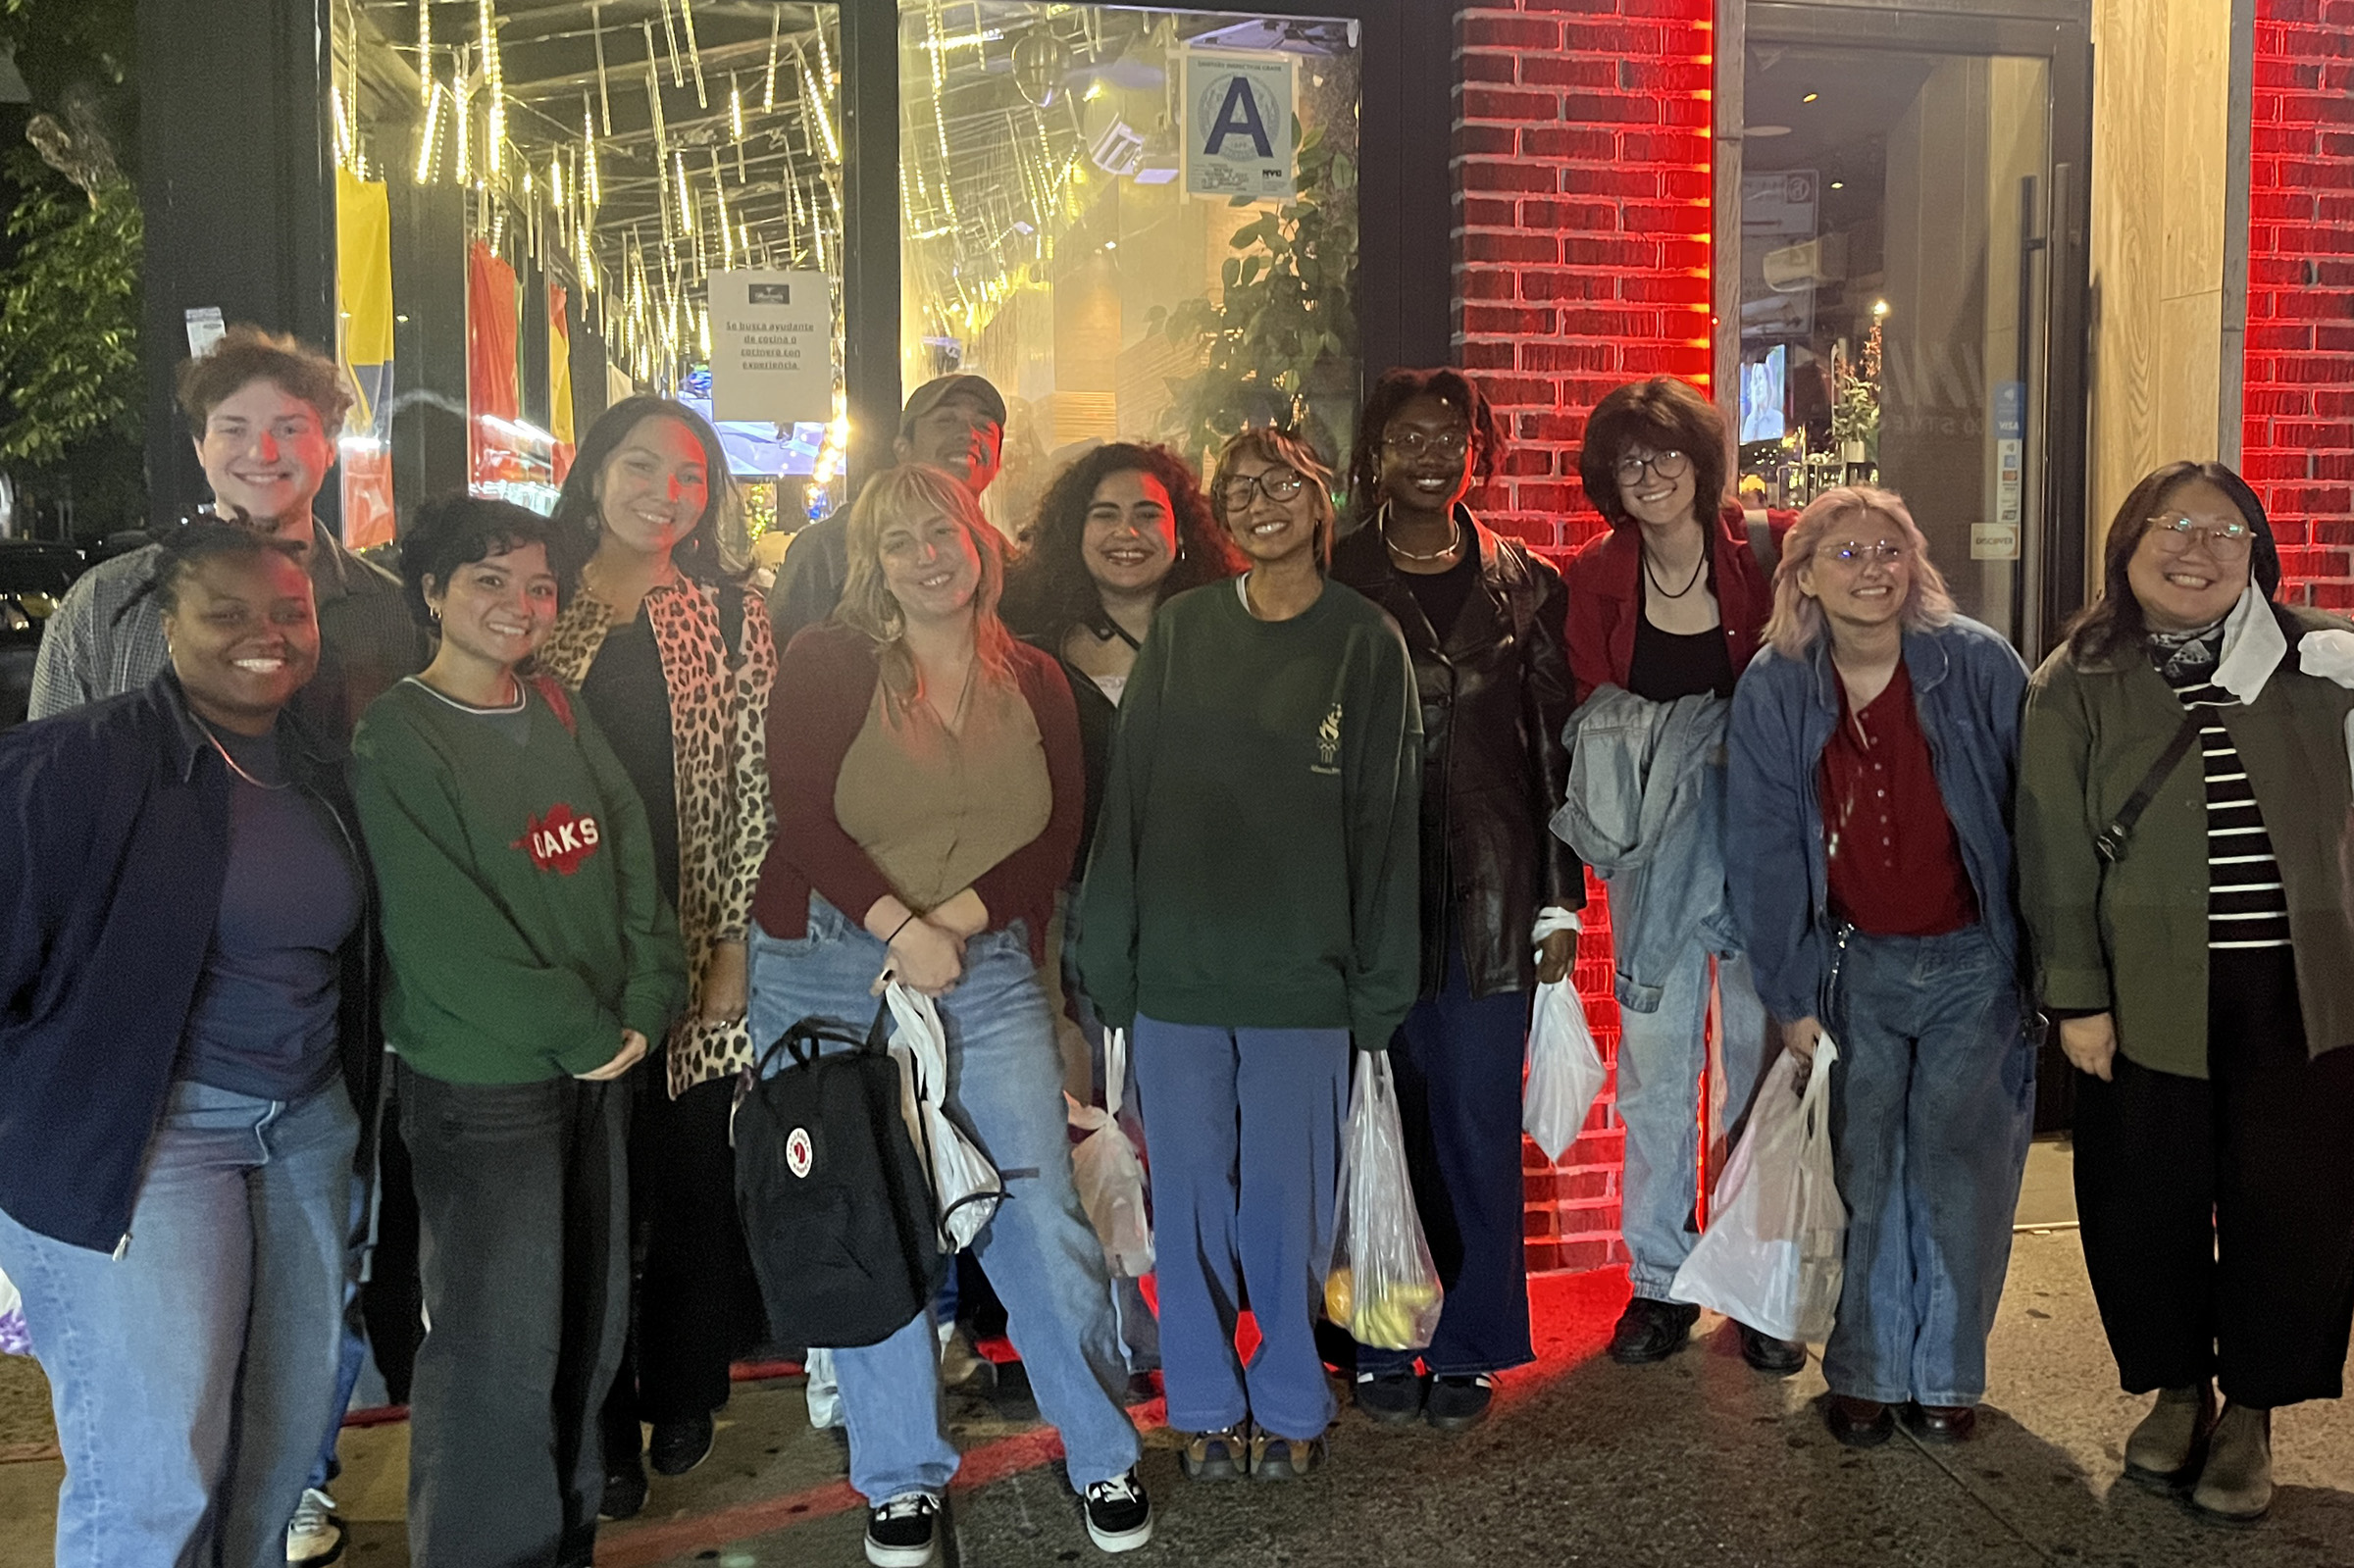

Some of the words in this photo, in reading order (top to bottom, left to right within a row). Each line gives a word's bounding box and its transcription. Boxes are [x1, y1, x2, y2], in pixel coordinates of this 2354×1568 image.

[1203, 76, 1273, 158] A
[726, 322, 738, 331] Se
[740, 322, 767, 331] busca
[769, 323, 814, 332] ayudante
[743, 335, 756, 344] de
[758, 335, 789, 344] cocina
[791, 335, 797, 344] o
[784, 348, 801, 358] con
[1998, 421, 2020, 430] VISA
